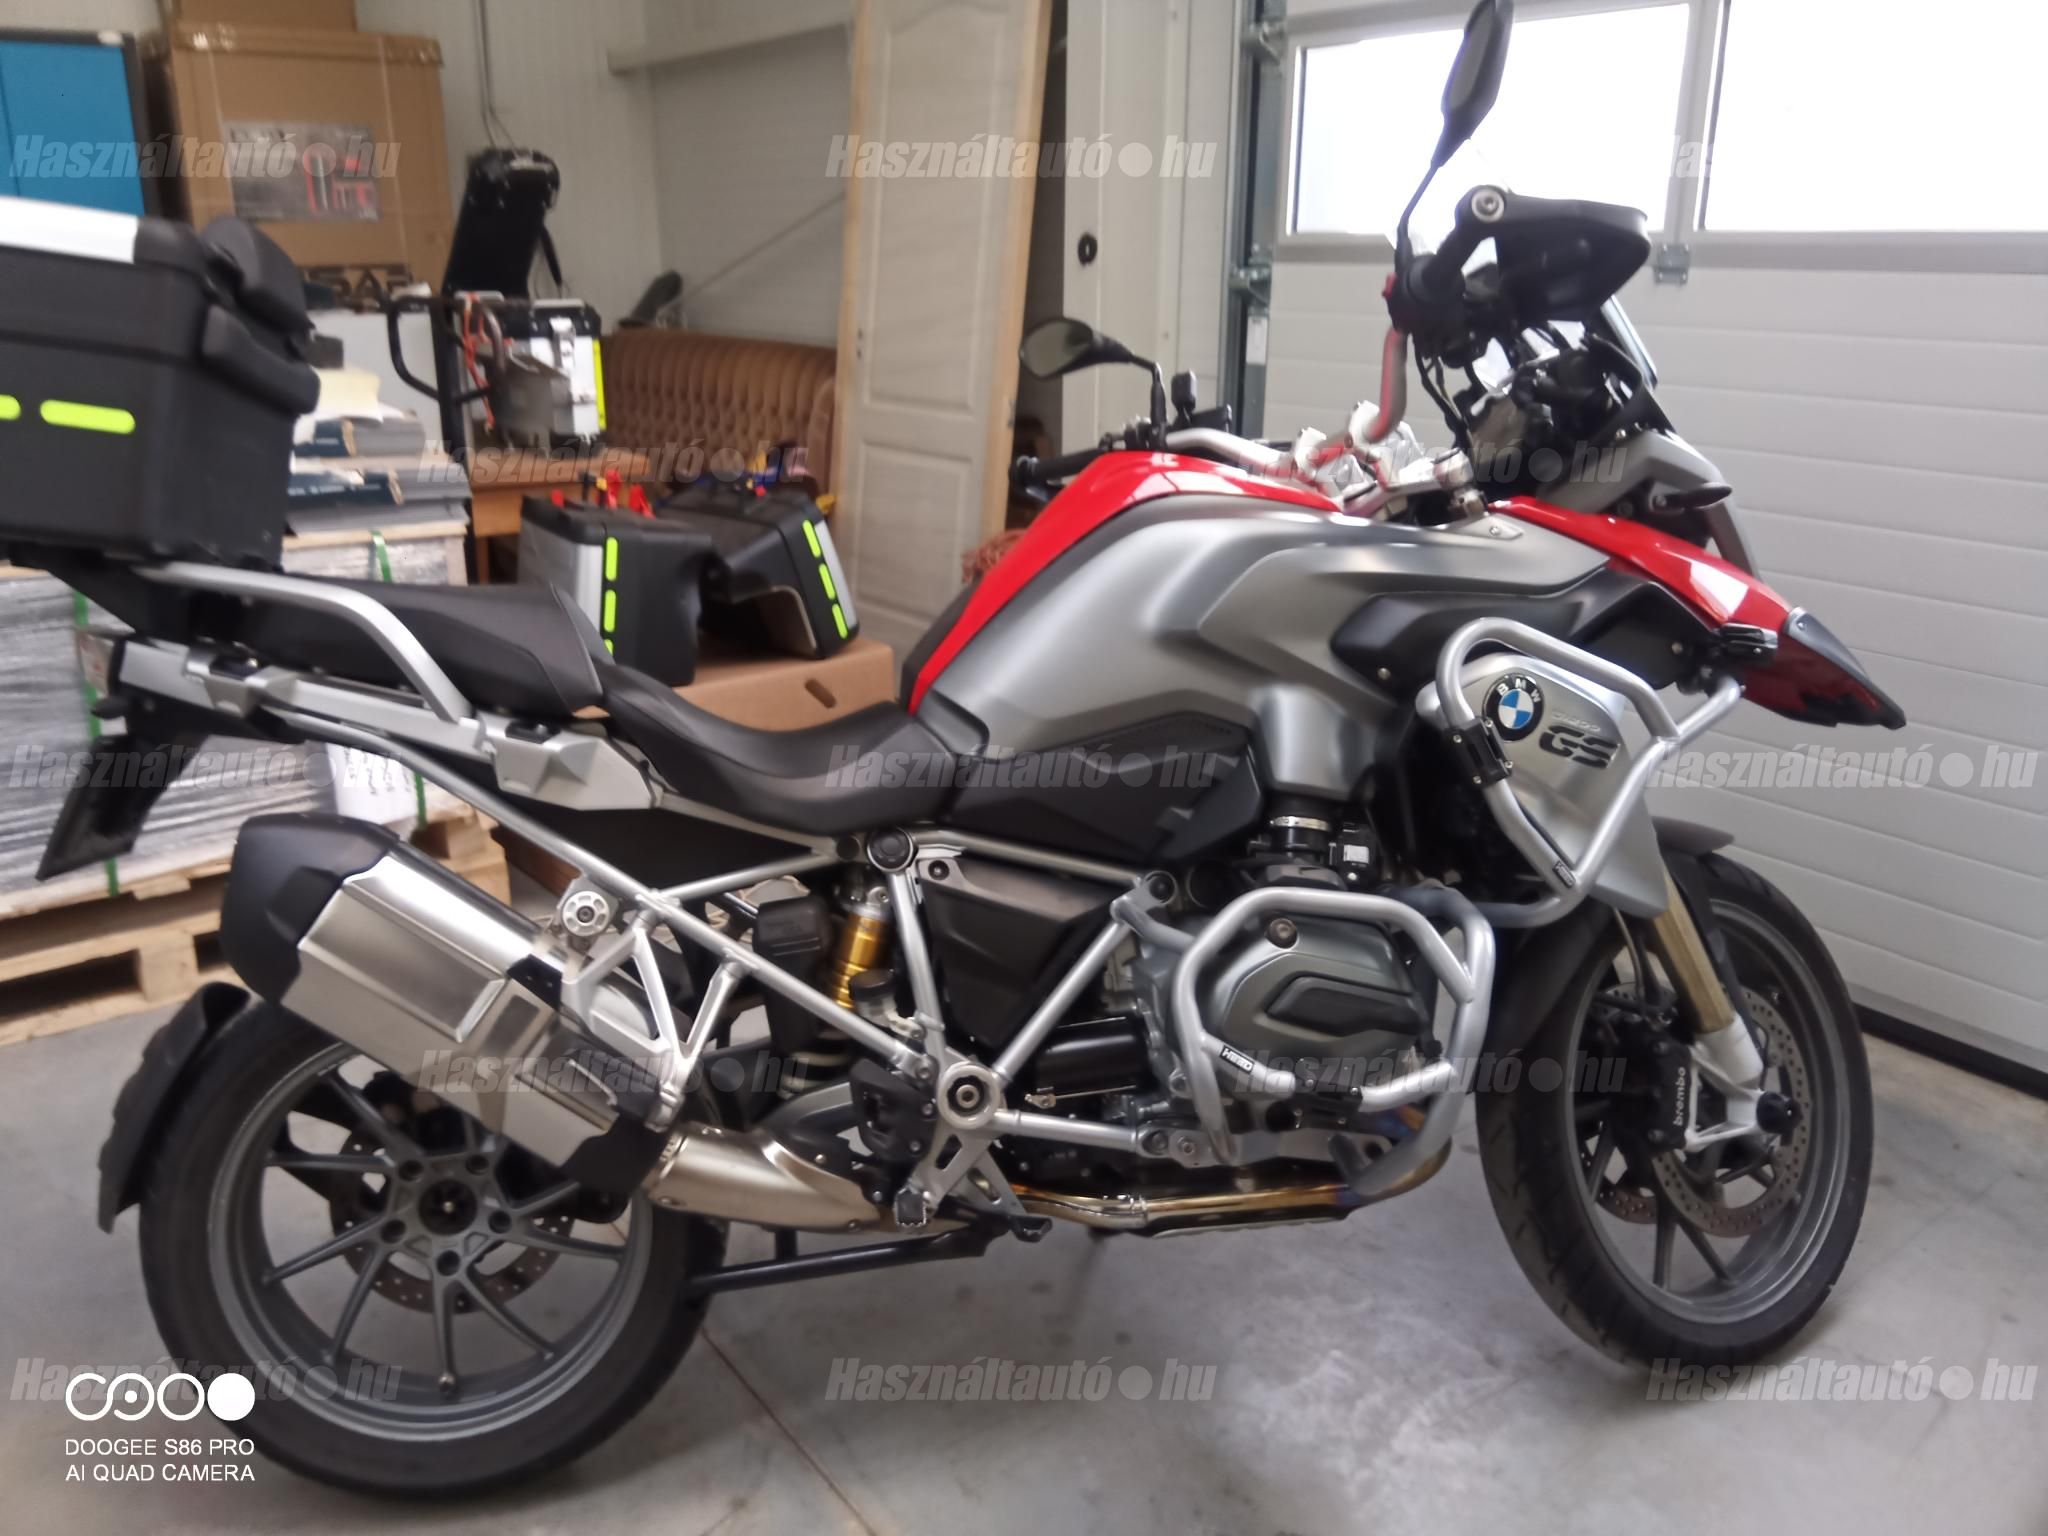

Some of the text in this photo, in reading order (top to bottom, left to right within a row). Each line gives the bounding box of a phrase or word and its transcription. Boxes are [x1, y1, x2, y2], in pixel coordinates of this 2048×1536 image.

[1496, 677, 1541, 704] BMW
[1539, 725, 1619, 769] GS
[1673, 1066, 1686, 1126] brembo
